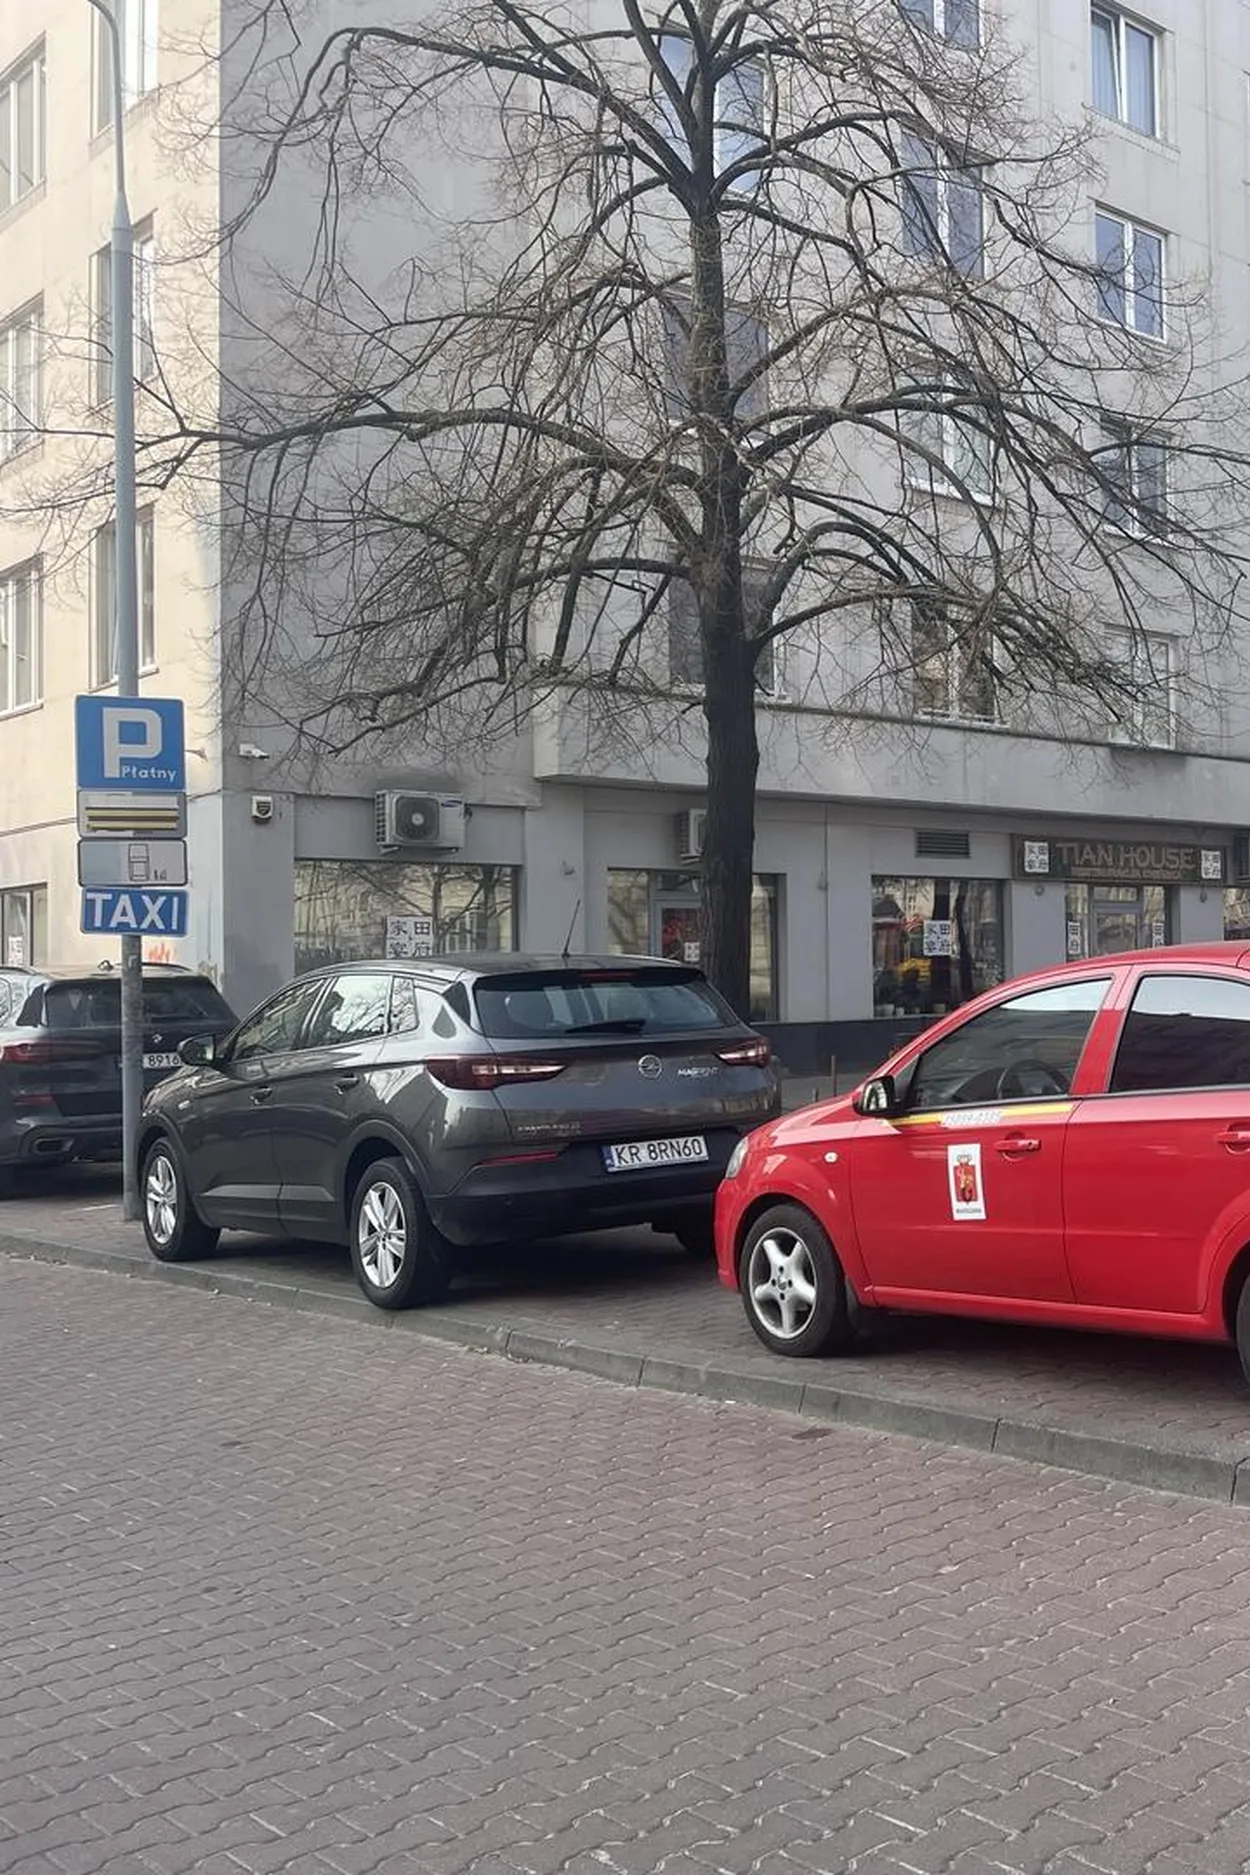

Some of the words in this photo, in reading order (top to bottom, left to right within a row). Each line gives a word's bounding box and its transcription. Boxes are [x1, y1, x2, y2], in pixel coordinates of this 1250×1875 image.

[103, 707, 162, 778] P
[122, 764, 177, 783] Płatny
[1055, 842, 1114, 866] TIAN
[1119, 844, 1196, 870] HOUSE
[86, 892, 179, 931] TAXI
[148, 1054, 181, 1067] 8916
[614, 1146, 641, 1165] KR
[649, 1138, 702, 1161] 8RN60
